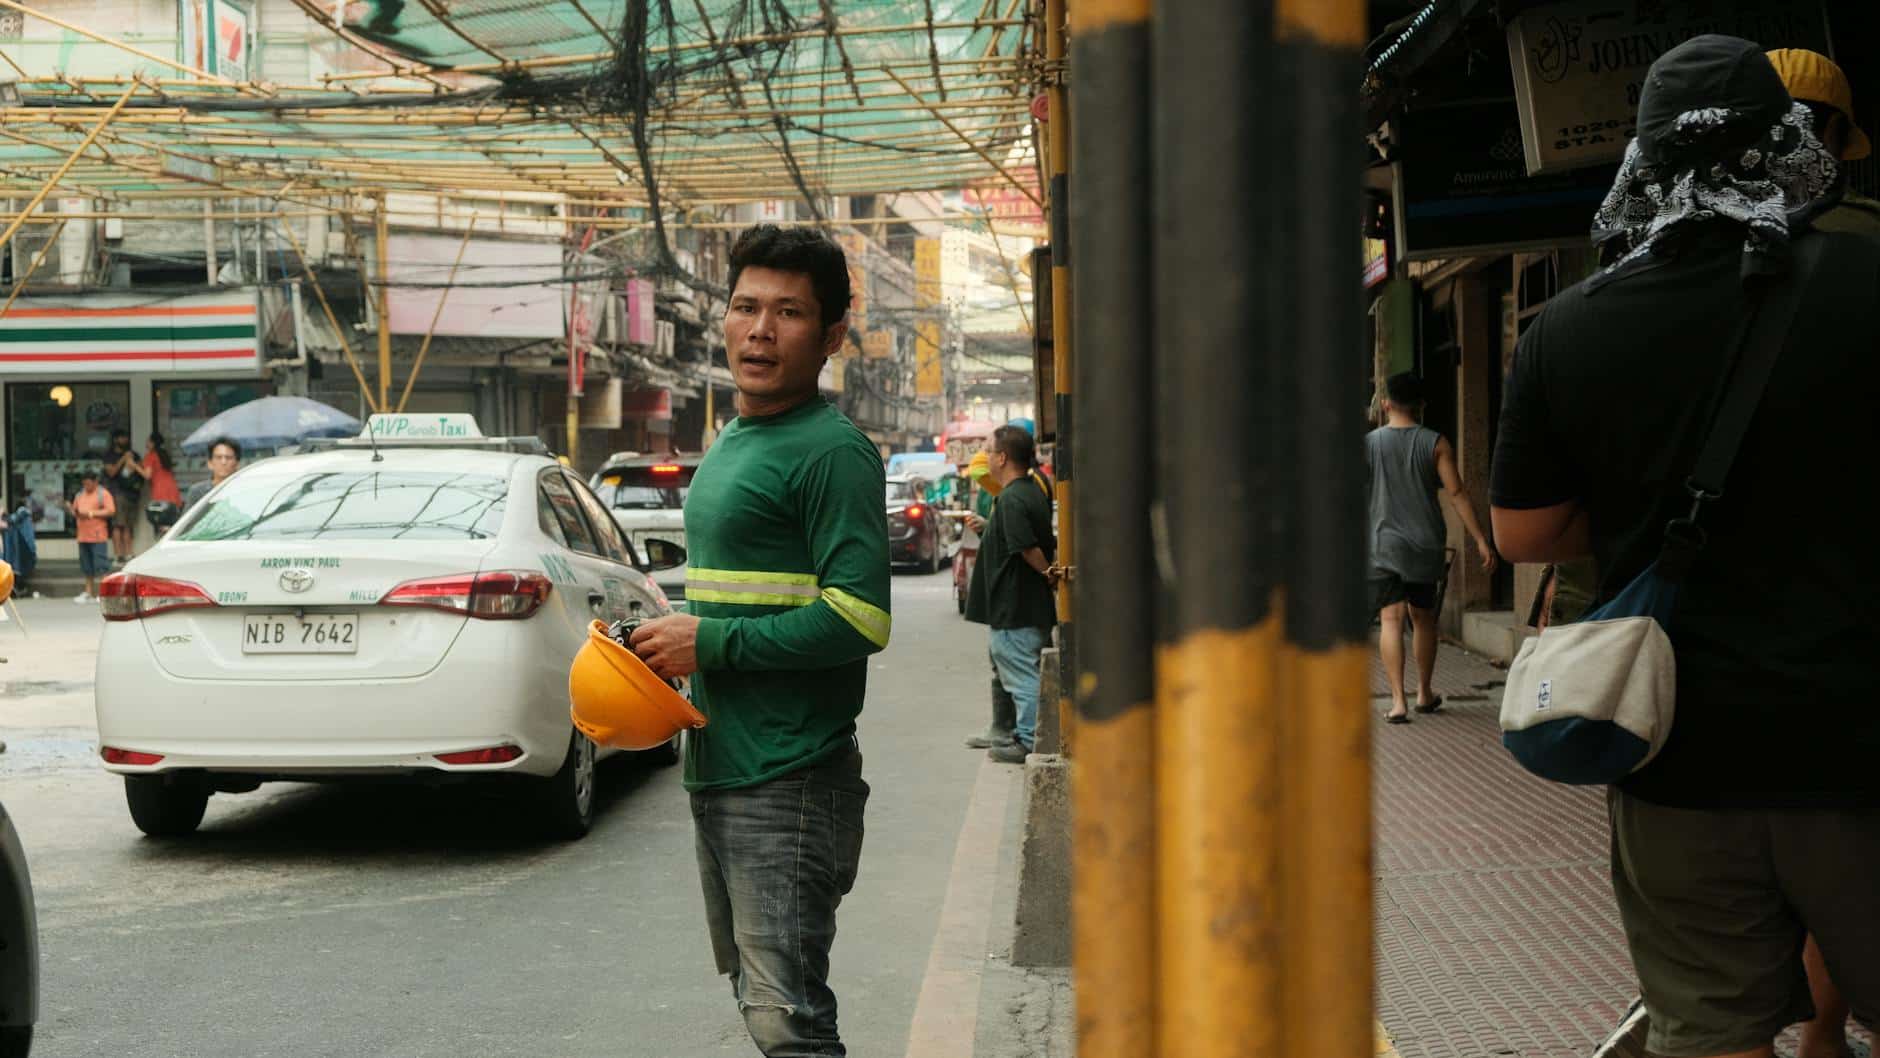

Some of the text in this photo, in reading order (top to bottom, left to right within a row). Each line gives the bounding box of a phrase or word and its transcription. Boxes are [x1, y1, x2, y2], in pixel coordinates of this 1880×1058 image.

[373, 417, 409, 436] AVP
[439, 417, 467, 436] Taxi
[260, 557, 341, 569] AARON VINZ PAUL
[246, 623, 354, 644] NIB 7642
